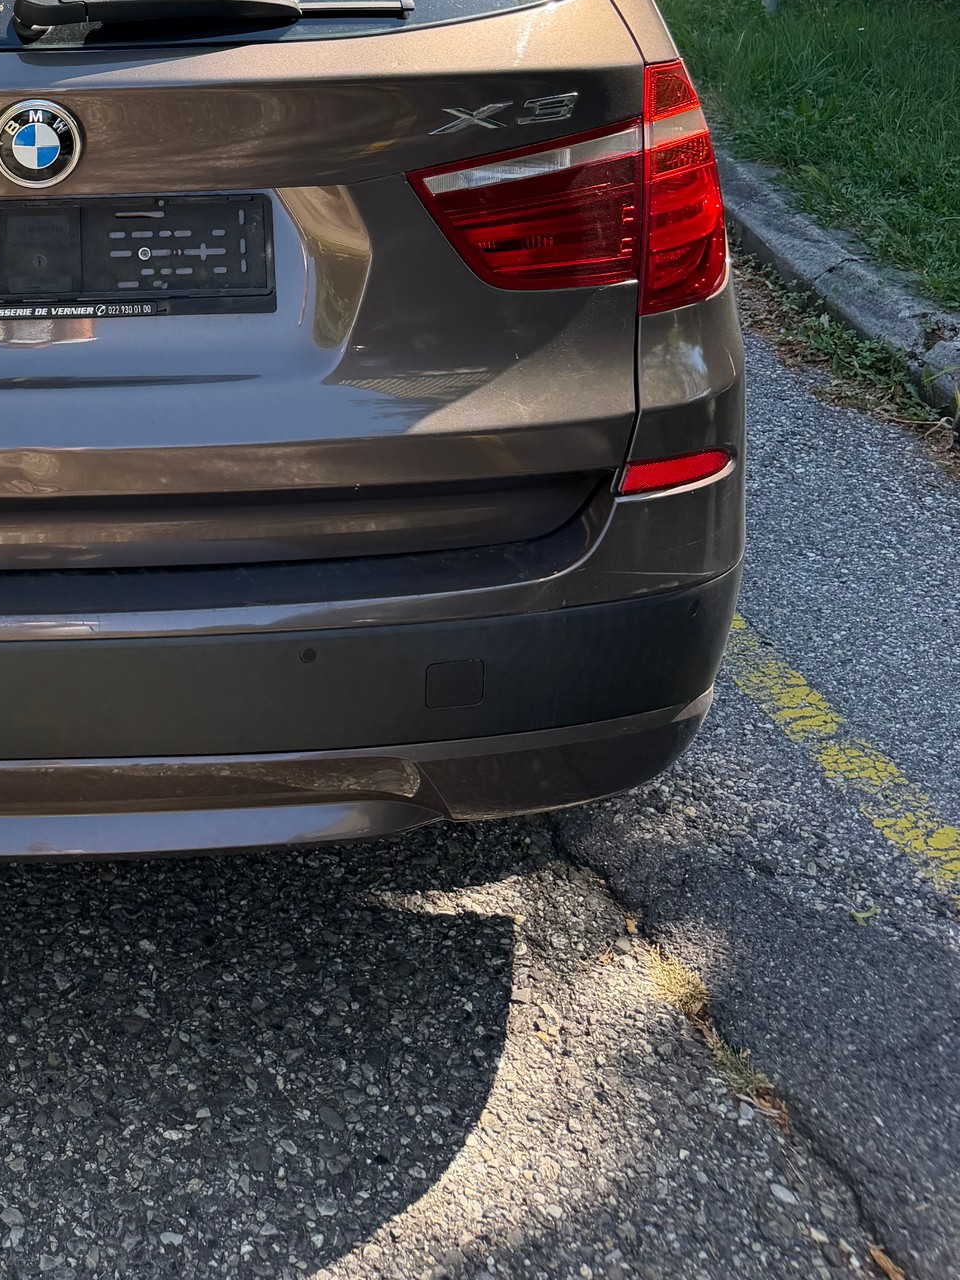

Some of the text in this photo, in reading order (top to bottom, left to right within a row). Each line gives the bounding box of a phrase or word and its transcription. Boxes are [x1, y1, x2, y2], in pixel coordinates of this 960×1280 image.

[4, 110, 68, 136] BMW
[427, 91, 579, 136] X3
[34, 308, 48, 316] DE
[51, 307, 94, 315] VERNIER
[108, 306, 120, 315] 022
[121, 305, 133, 314] 930
[134, 305, 141, 314] 01
[143, 304, 151, 313] 00
